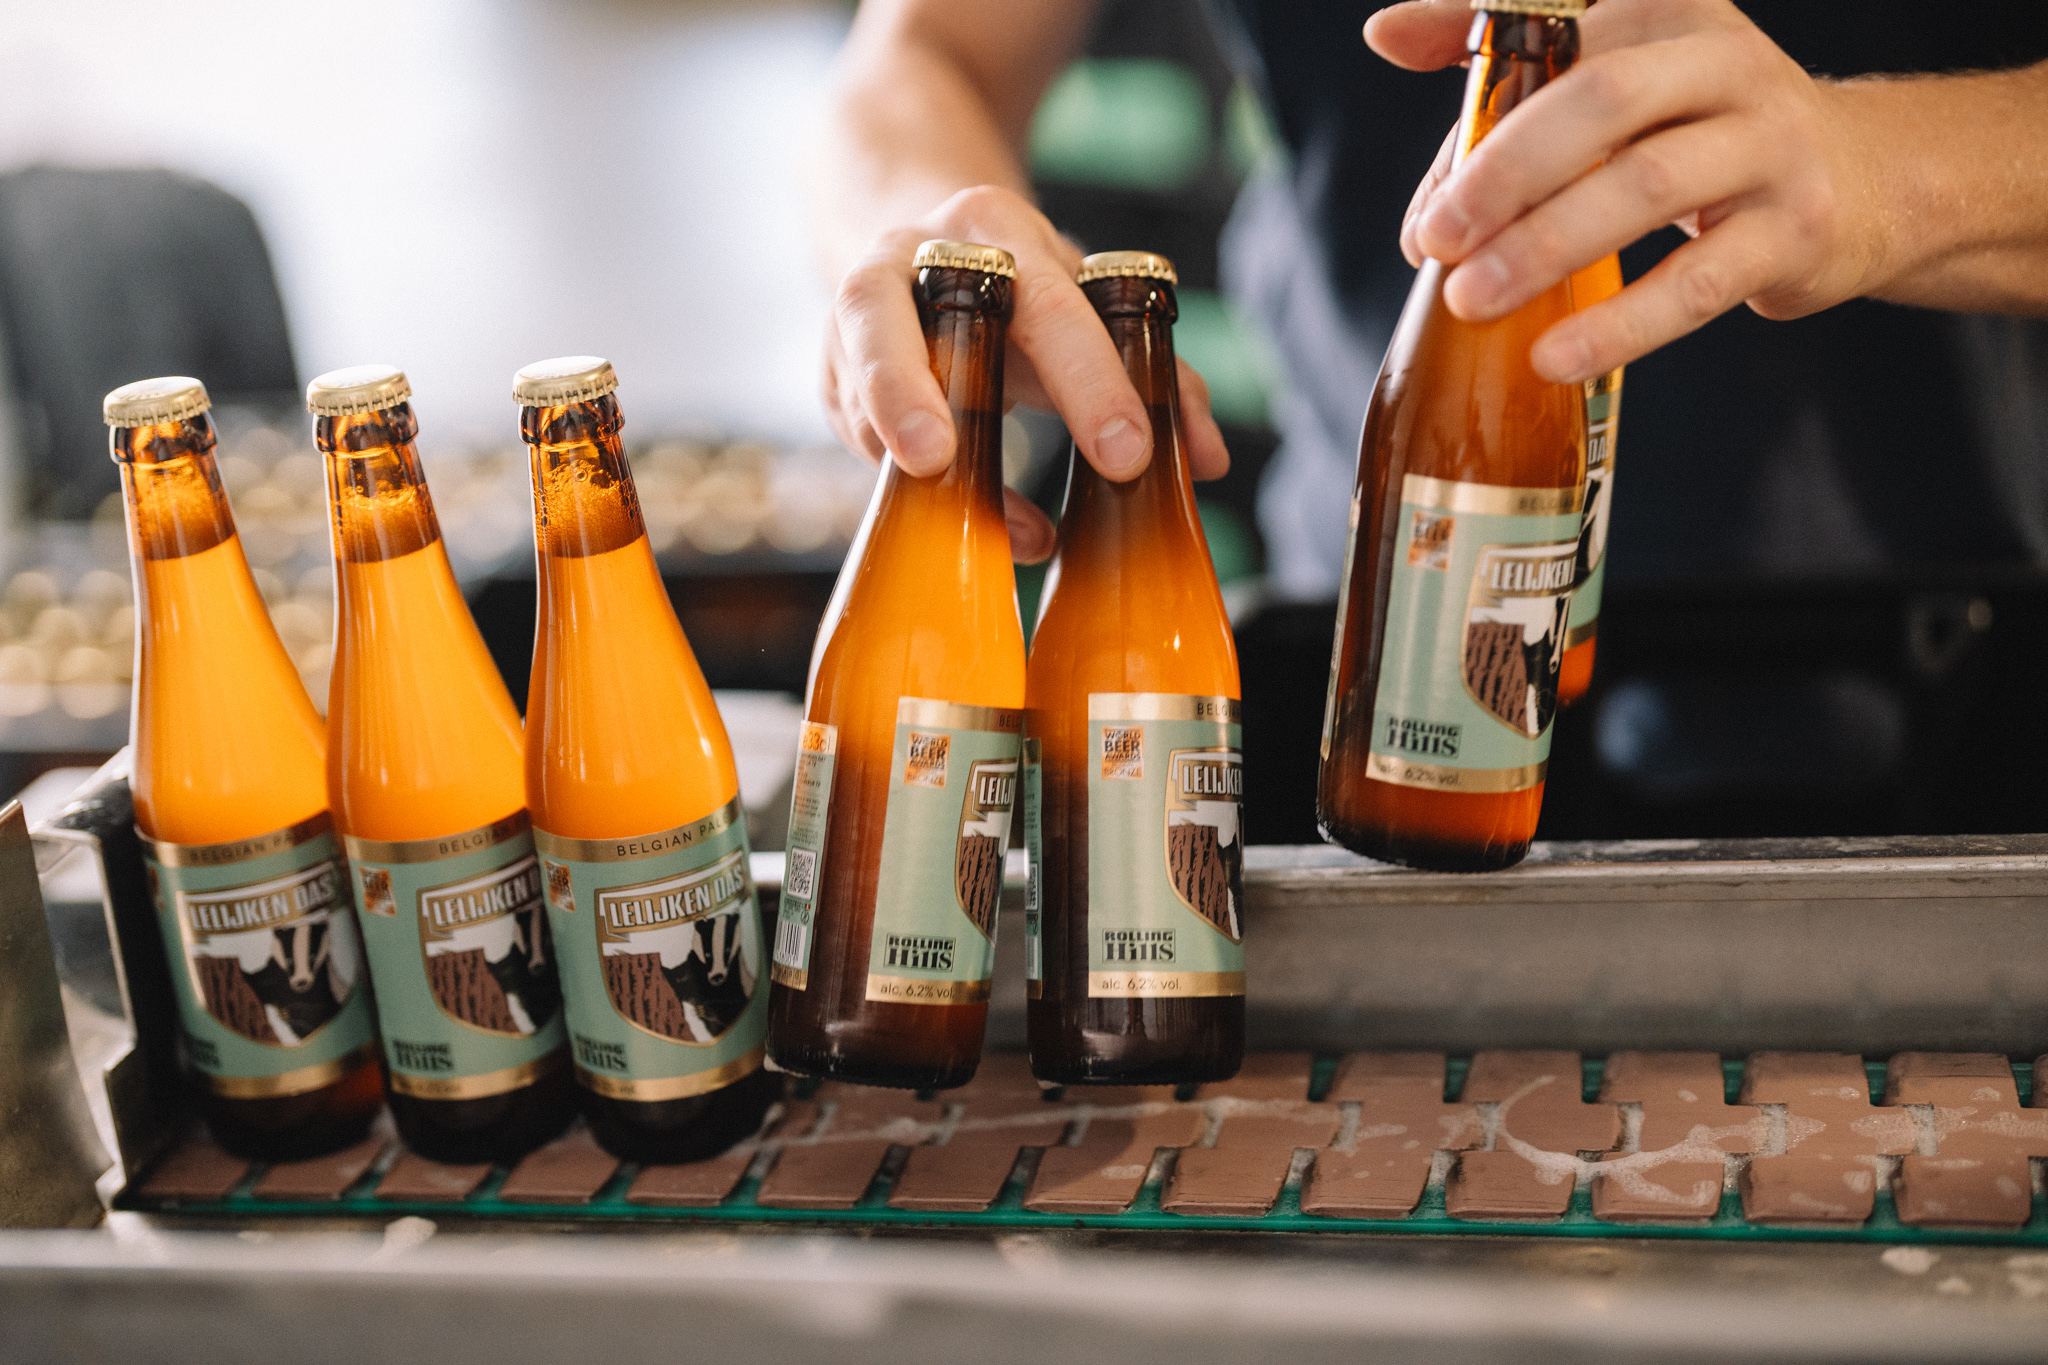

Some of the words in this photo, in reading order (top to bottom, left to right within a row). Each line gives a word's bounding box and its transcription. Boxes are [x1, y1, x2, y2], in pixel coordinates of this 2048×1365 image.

[1104, 730, 1141, 740] WORLD
[910, 746, 946, 759] BEER
[1104, 740, 1140, 752] BEER
[617, 831, 692, 856] BELGIAN
[188, 891, 290, 931] LELIJKEN
[293, 873, 333, 912] DAS
[432, 872, 528, 927] LELIJKEN
[609, 883, 711, 927] LELIJKEN
[714, 863, 743, 908] DAS
[888, 936, 953, 950] ROLLING
[1104, 932, 1173, 942] ROLLING
[885, 947, 953, 970] Hills
[1106, 943, 1174, 960] Hills
[880, 983, 902, 996] alc.
[905, 984, 934, 998] 6.2%
[936, 985, 955, 999] vol.
[1102, 978, 1123, 990] alc.
[1161, 978, 1182, 991] vol.
